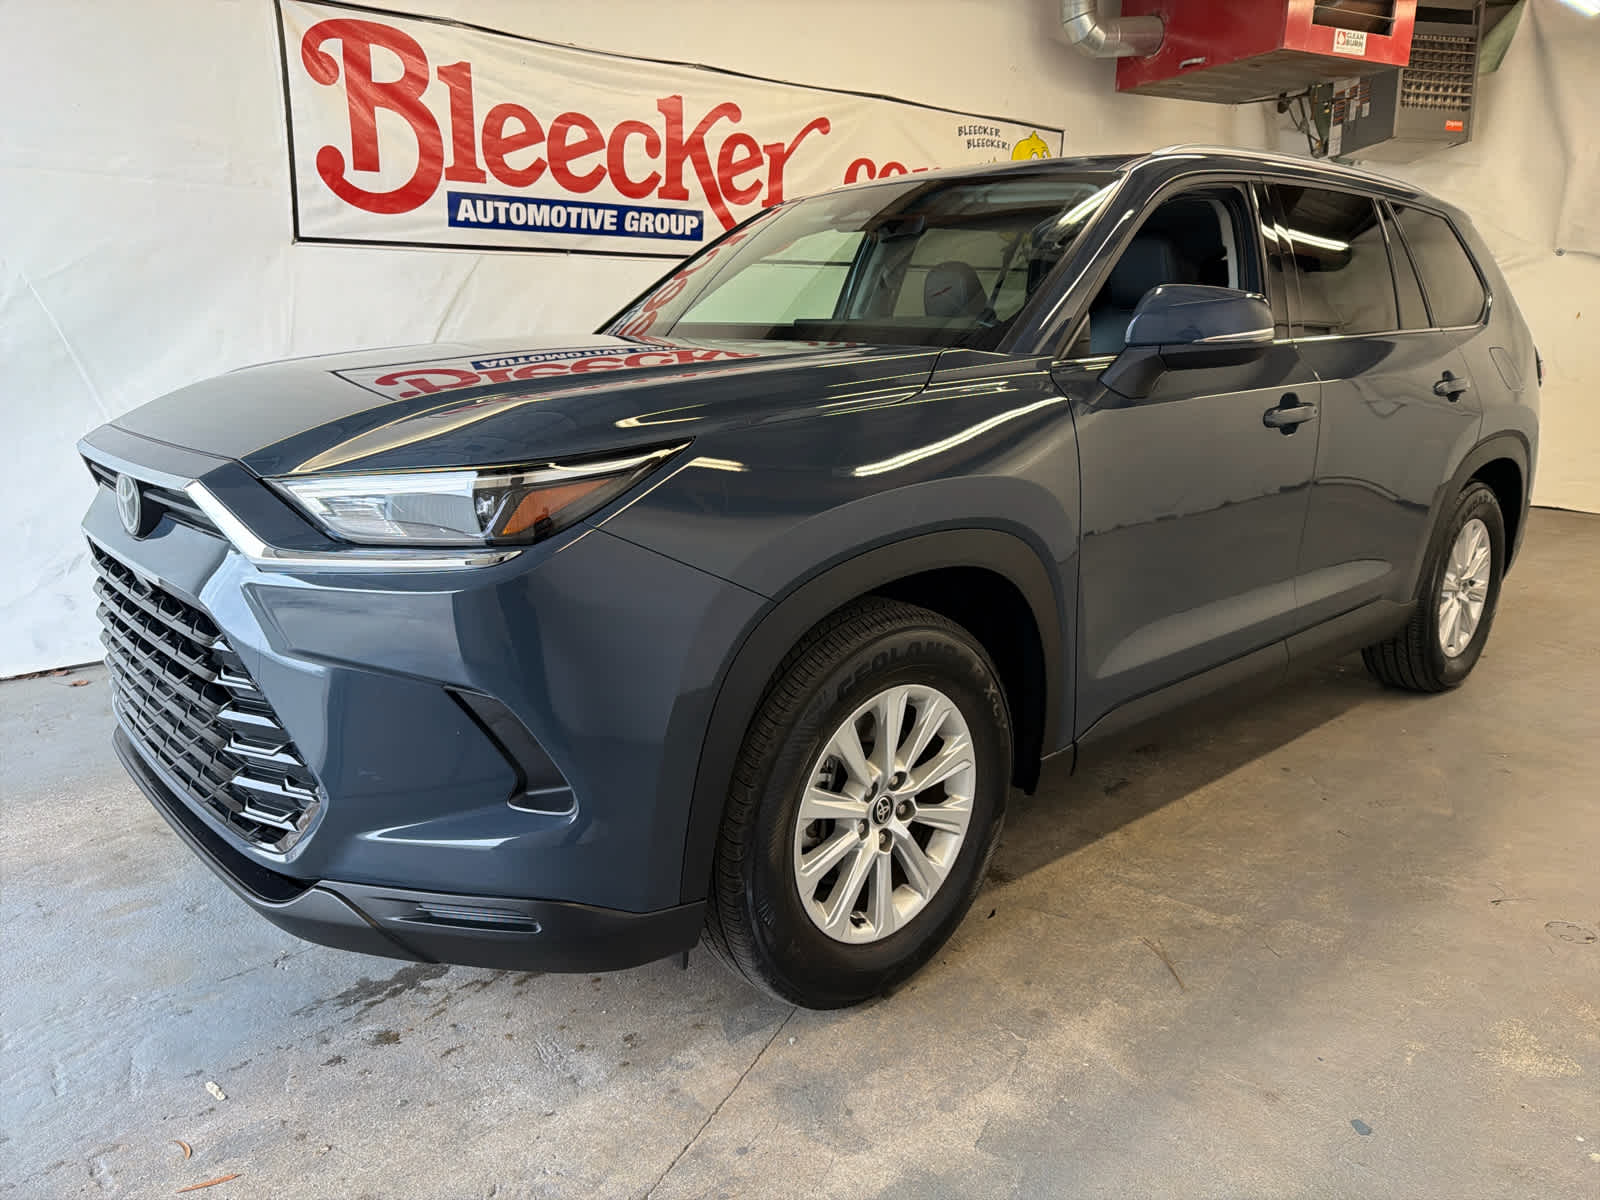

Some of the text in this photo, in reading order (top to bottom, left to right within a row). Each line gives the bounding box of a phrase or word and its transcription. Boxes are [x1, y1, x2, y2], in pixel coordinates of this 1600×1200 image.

[301, 18, 830, 230] Bleecker
[457, 198, 700, 236] AUTOMOTIVE GROUP
